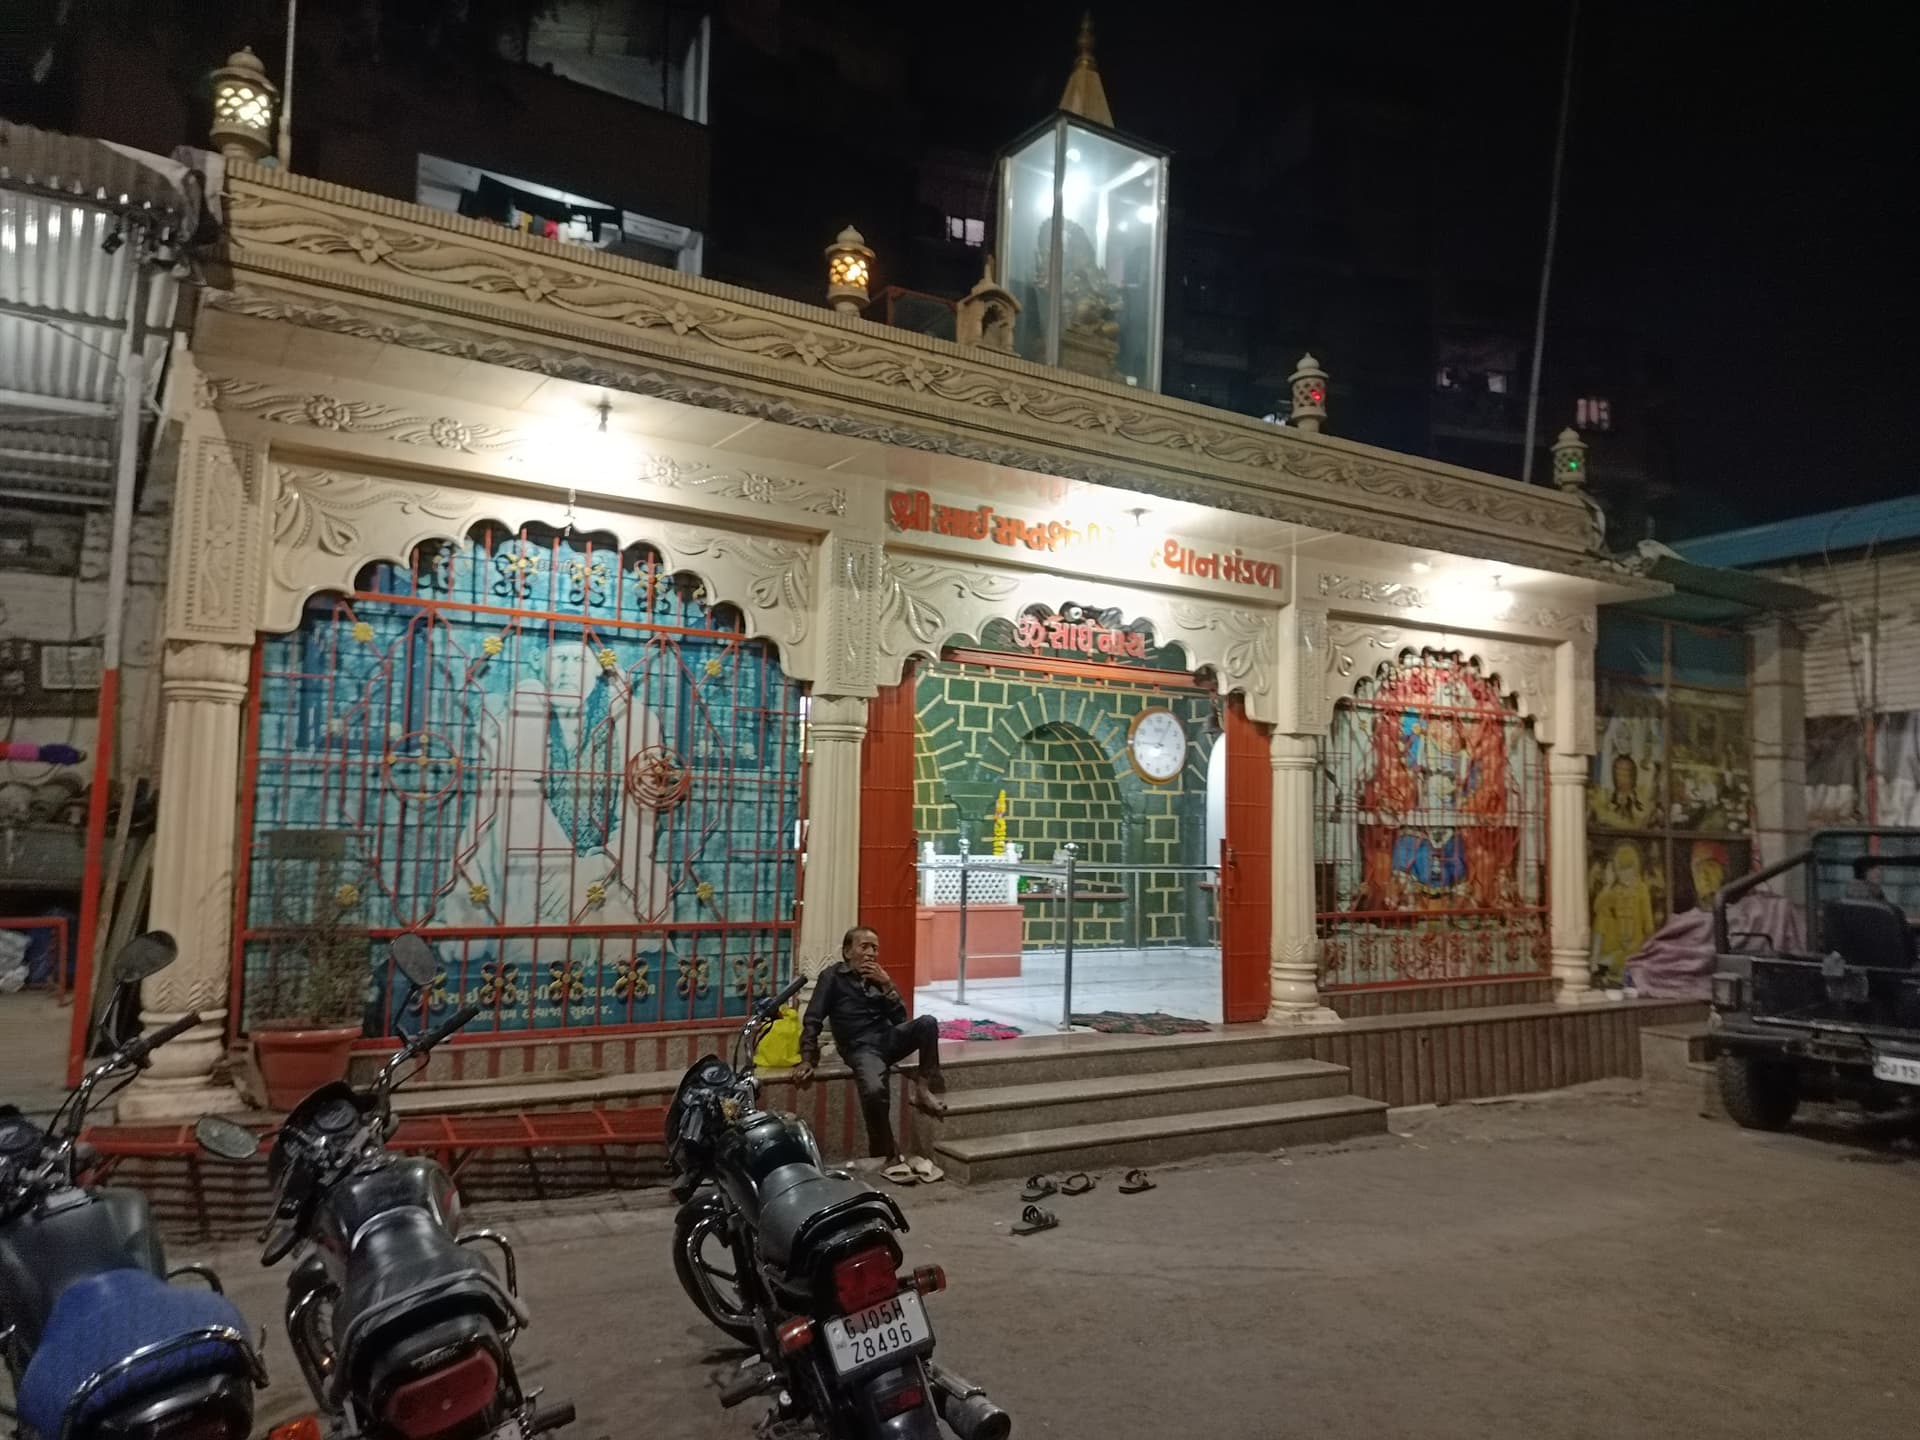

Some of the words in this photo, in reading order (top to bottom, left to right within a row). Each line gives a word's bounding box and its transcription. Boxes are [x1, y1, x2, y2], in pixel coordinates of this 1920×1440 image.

[888, 490, 931, 533] શ્રી
[1222, 549, 1282, 590] મંડળ
[843, 1299, 904, 1339] GJ05H
[851, 1322, 912, 1363] Z8496
